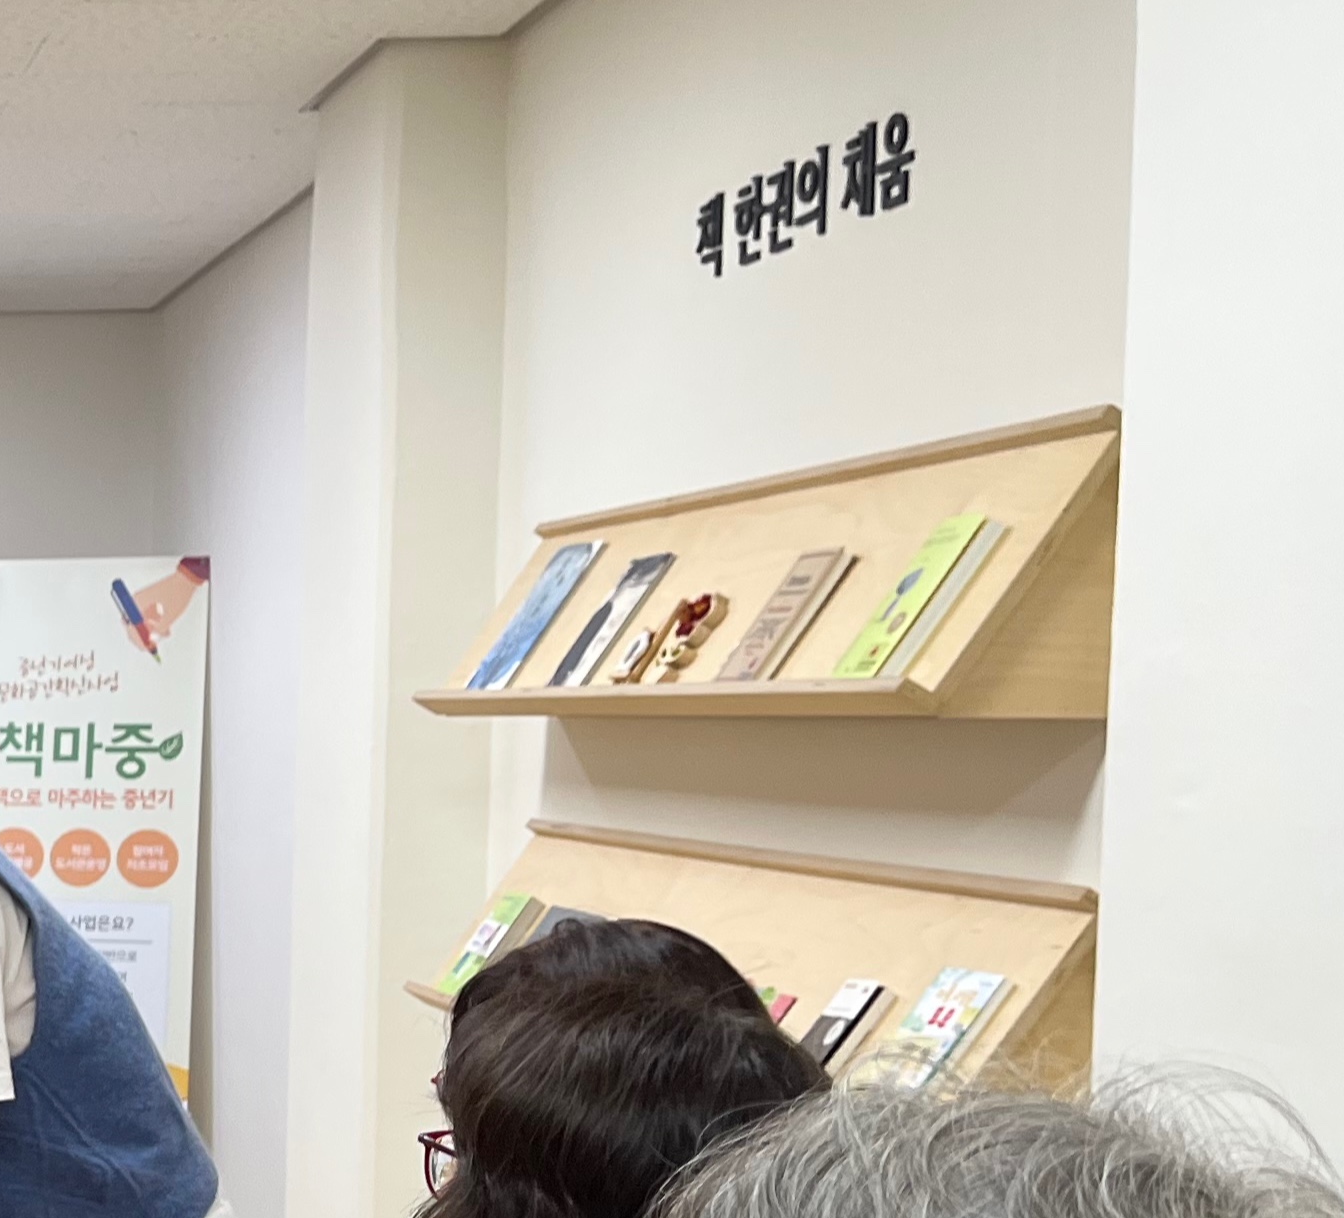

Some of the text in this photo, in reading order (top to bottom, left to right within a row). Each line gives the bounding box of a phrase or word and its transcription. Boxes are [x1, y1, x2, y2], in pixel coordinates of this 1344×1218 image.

[696, 112, 916, 277] 책 한권의 채움
[47, 788, 117, 809] 마주하는
[123, 788, 175, 810] 중년기
